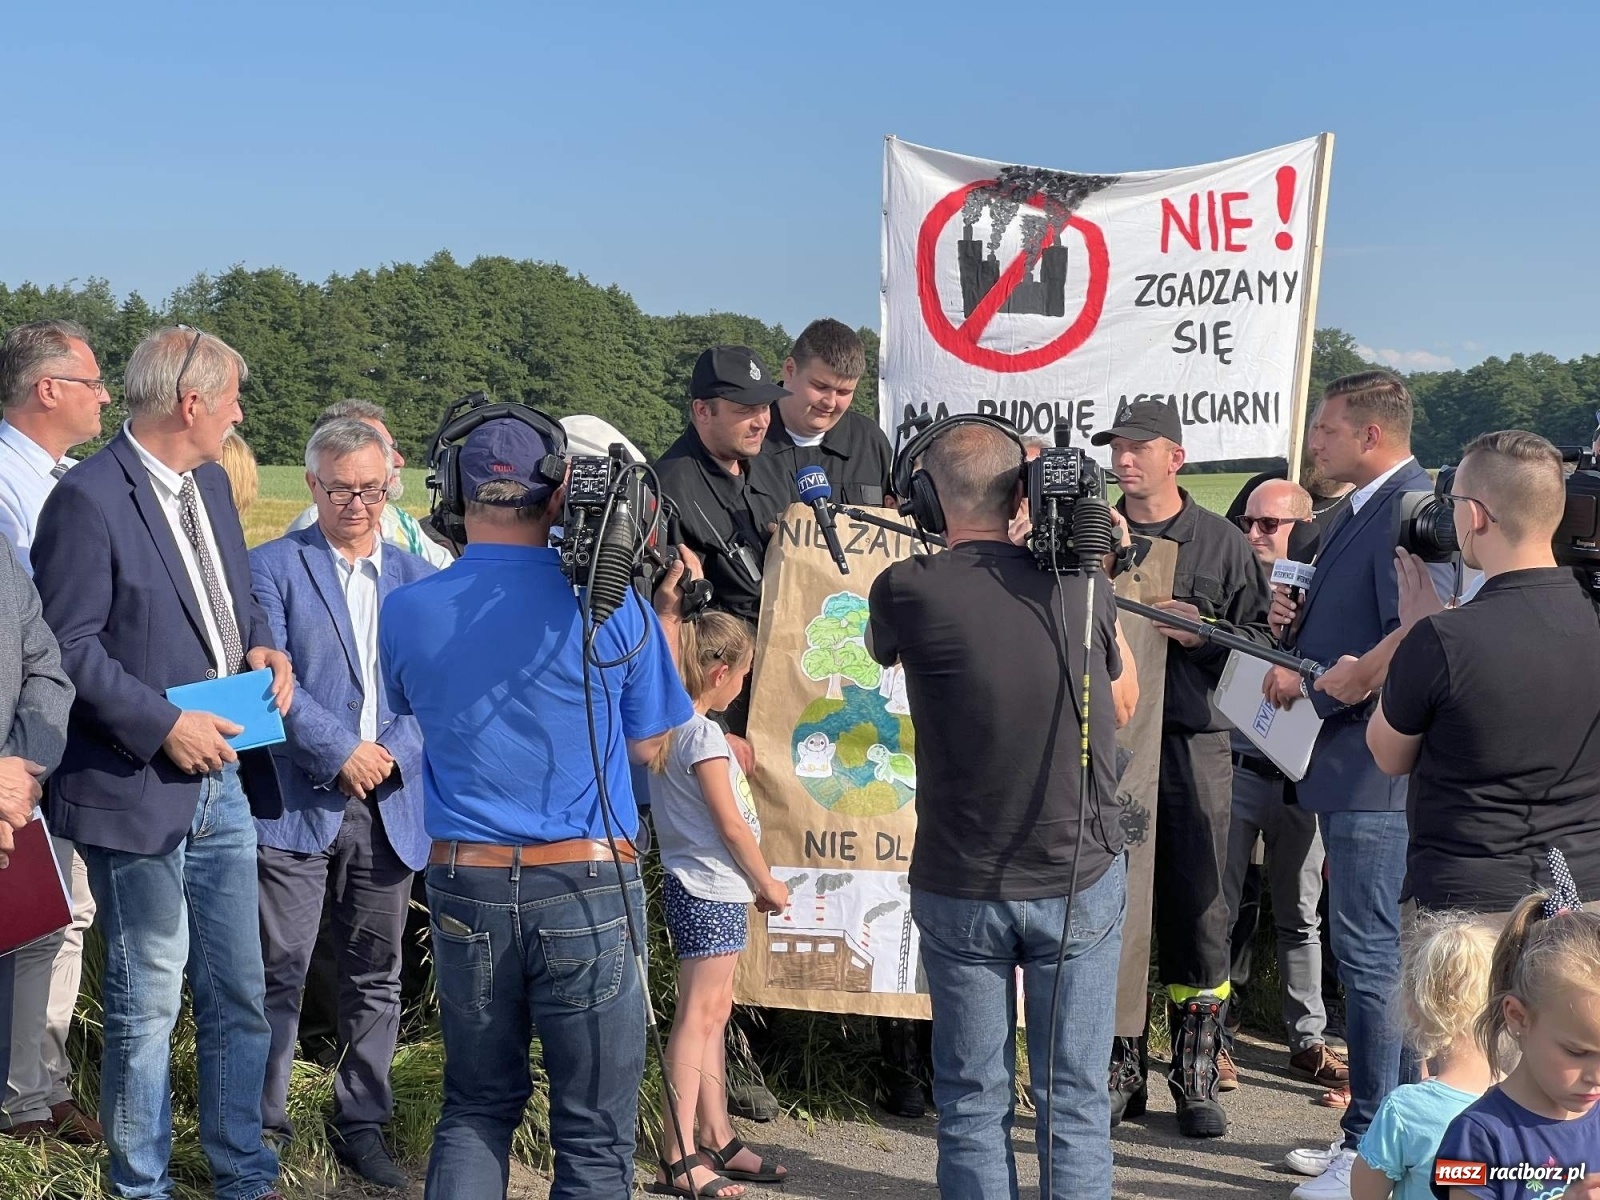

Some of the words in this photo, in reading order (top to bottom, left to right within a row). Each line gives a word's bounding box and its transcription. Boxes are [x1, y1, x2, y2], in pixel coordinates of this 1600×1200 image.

[1161, 190, 1253, 254] NIE
[1134, 268, 1299, 308] ZGADZAMY
[1173, 320, 1234, 365] SIĘ
[1113, 391, 1280, 426] AALCIARNI
[799, 473, 828, 491] TVP
[778, 518, 829, 550] NIE
[1255, 700, 1275, 732] TVP
[804, 830, 858, 861] NIE
[876, 831, 911, 861] DL
